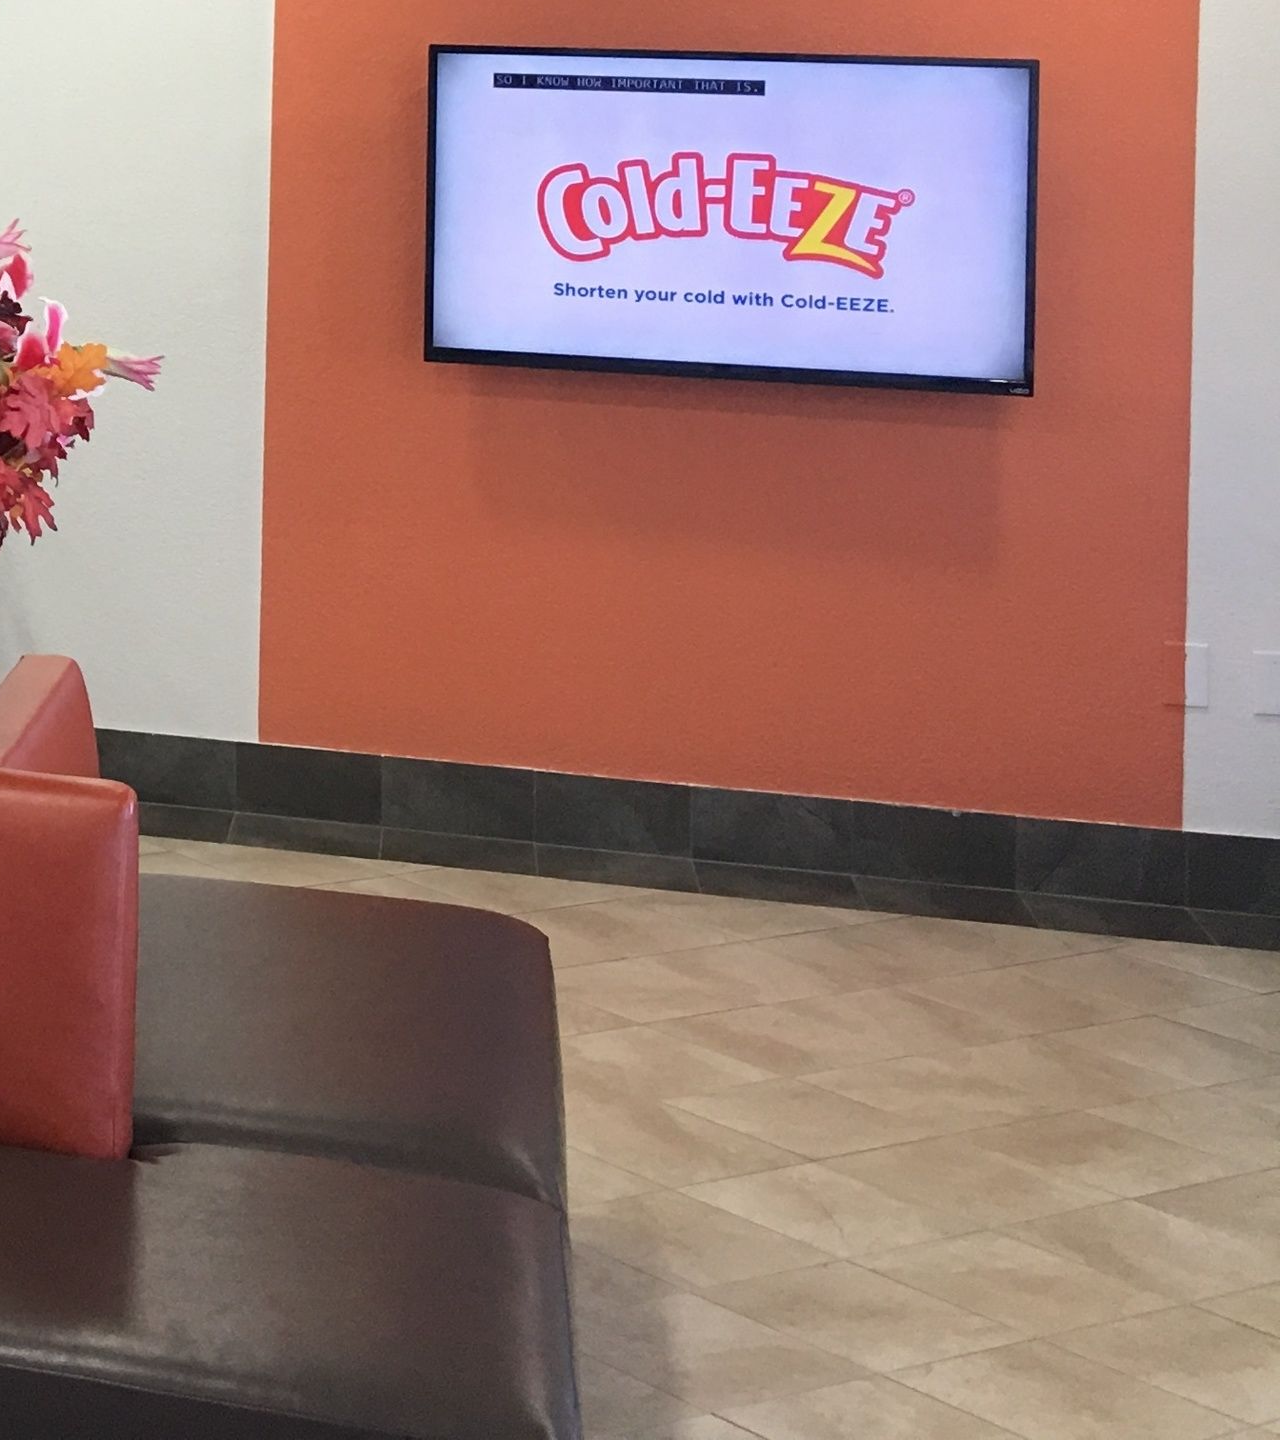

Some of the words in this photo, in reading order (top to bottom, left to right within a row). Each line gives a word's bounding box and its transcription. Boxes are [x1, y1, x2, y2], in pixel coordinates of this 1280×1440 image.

[495, 74, 513, 85] SO
[536, 75, 570, 87] KNOW
[576, 77, 602, 88] HOW
[610, 77, 683, 90] IMPORTANT
[694, 80, 726, 91] THAT
[553, 282, 628, 299] Shorten
[634, 289, 678, 302] your
[683, 290, 725, 304] cold
[732, 291, 774, 307] with
[781, 294, 895, 313] Cold-EEZE.
